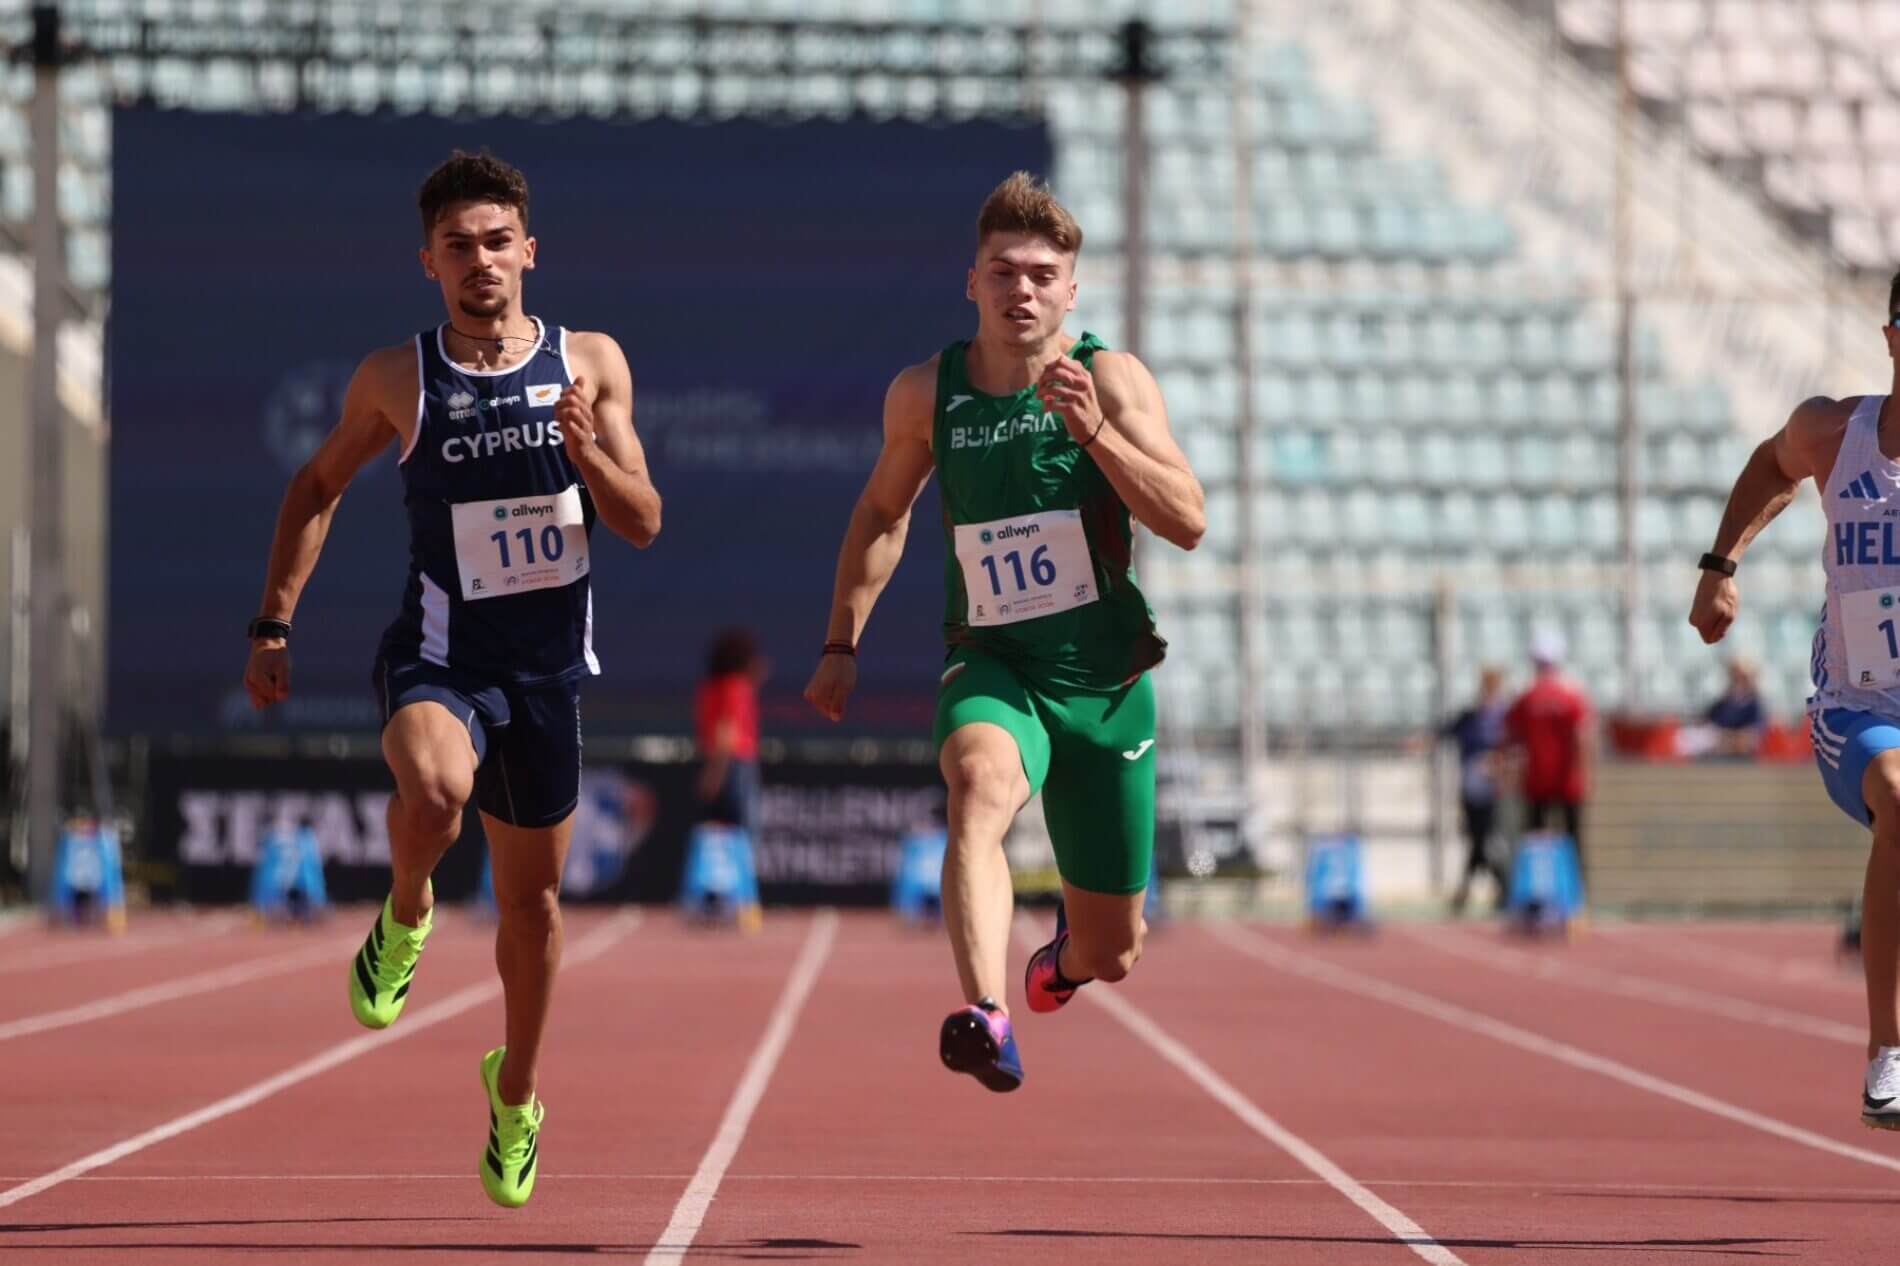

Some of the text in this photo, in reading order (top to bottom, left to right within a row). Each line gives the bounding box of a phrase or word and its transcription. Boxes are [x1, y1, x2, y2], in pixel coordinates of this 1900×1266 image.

[442, 421, 564, 463] CYPRUS
[951, 411, 1058, 449] BULGARIA
[512, 504, 553, 518] allwyn
[490, 524, 564, 569] 110
[997, 522, 1040, 541] allwyn
[980, 543, 1057, 596] 116
